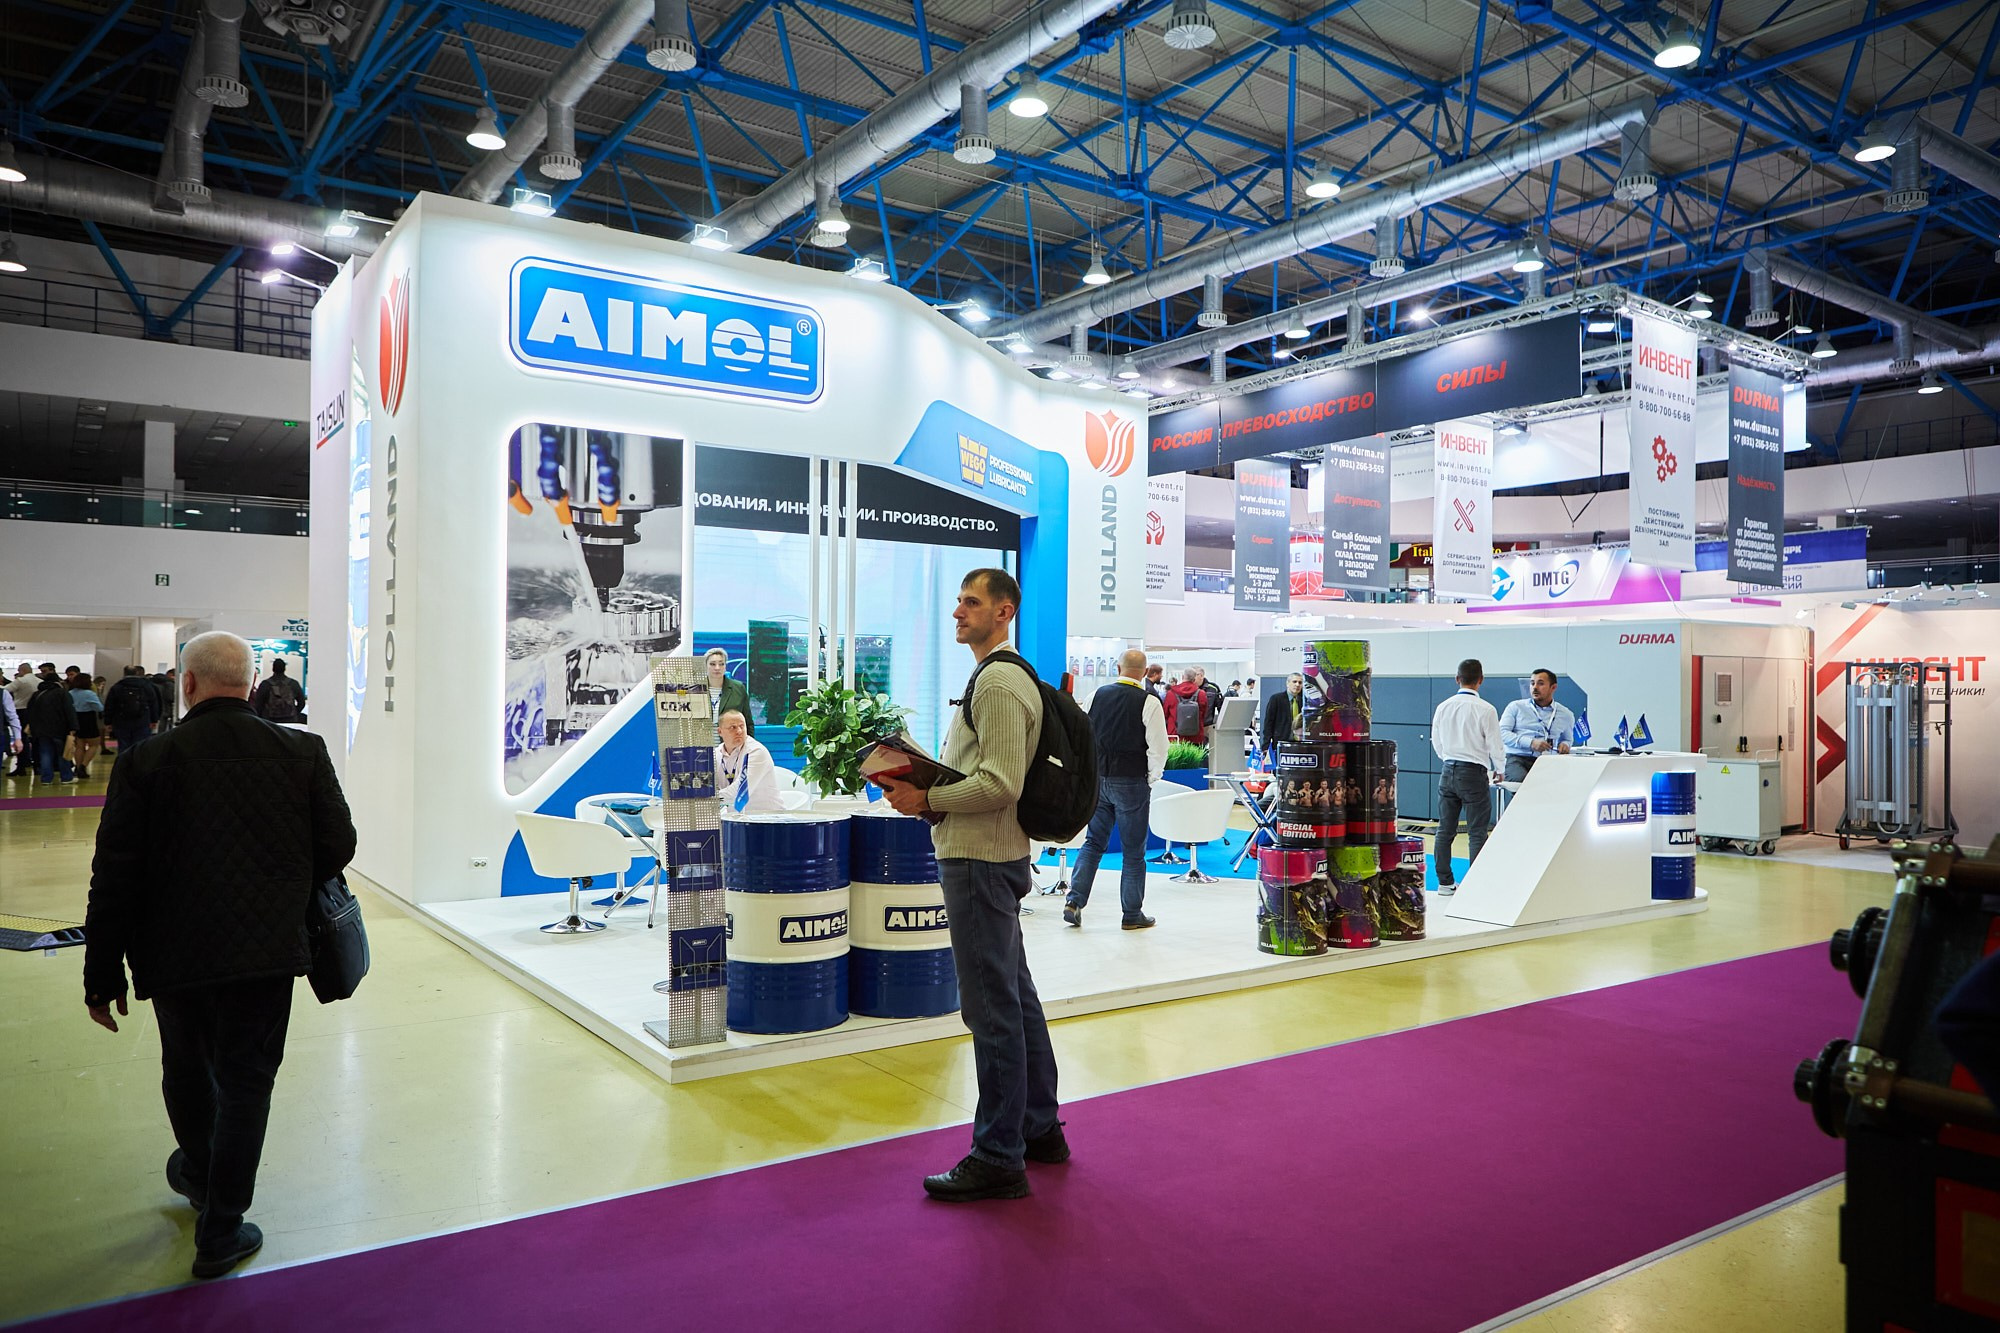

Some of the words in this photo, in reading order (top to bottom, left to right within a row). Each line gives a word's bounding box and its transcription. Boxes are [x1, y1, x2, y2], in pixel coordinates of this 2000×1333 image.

[1639, 344, 1692, 380] ИНВЕНТ
[1635, 382, 1696, 406] www.in-vent.ru
[1733, 386, 1779, 413] DURMA
[1152, 426, 1213, 453] РОССИЯ
[1222, 391, 1375, 438] ПРЕВОСХОДСТВО
[1436, 360, 1507, 393] СИЛЫ
[1639, 401, 1691, 422] 8-800-700-66-88
[317, 390, 345, 440] TAISUN
[1733, 418, 1779, 437] www.durma.ru
[1440, 432, 1487, 455] ИНВЕНТ
[1733, 434, 1741, 444] +7
[1741, 436, 1755, 448] (831)
[1330, 443, 1385, 460] www.durma.ru
[960, 449, 986, 473] WEGO
[1330, 458, 1339, 467] +7
[1339, 459, 1355, 471] (831)
[1356, 460, 1385, 474] 266-3-555
[1437, 460, 1491, 475] www.in-vent.ru
[989, 454, 1034, 485] PROFESSIONAL
[989, 471, 1026, 496] LUBRICANTS
[1240, 471, 1286, 489] DURMA
[1440, 473, 1488, 488] 8-800-700-66-88
[1737, 474, 1776, 492] Надёжность
[1240, 494, 1286, 507] www.durma.ru
[1333, 493, 1382, 510] Доступность
[1647, 507, 1680, 519] ПОСТОЯННО
[883, 510, 999, 533] ПРОИЗВОДСТВО.
[1643, 516, 1684, 530] ДЕЙСТВУЮЩИЙ
[1744, 517, 1768, 530] Гарантия
[1332, 530, 1353, 541] Самый
[1354, 532, 1382, 544] большой
[1635, 526, 1693, 541] ДЕМОНСТРАЦИОННЫЙ
[1737, 528, 1744, 537] от
[1744, 529, 1775, 541] российского
[1101, 484, 1118, 612] HOLLAND
[1343, 542, 1348, 550] в
[1349, 541, 1371, 552] России
[1659, 539, 1669, 547] ЗАЛ
[1335, 550, 1353, 560] склад
[1354, 552, 1379, 562] станков
[1447, 552, 1481, 561] СЕРВИС-ЦЕНТР
[1733, 548, 1778, 562] постгарантийное
[1345, 561, 1375, 570] запасных
[1442, 560, 1485, 569] ДОПОЛНИТЕЛЬНАЯ
[1736, 557, 1774, 571] обслуживание
[385, 435, 398, 713] HOLLAND
[1346, 569, 1368, 578] частей
[1452, 568, 1477, 576] ГАРАНТИЯ
[1533, 572, 1570, 588] DMTG
[1619, 633, 1675, 645] DURMA
[1856, 656, 1986, 682] ИЕНТ
[661, 702, 691, 712] СОЖ
[1280, 755, 1316, 766] AIMOL
[1599, 802, 1646, 821] AIMOL
[1280, 823, 1313, 832] SPECIAL
[1282, 830, 1316, 839] EDITION
[1669, 831, 1696, 843] AIM
[1403, 853, 1424, 863] AIM
[782, 913, 848, 939] AIMOL
